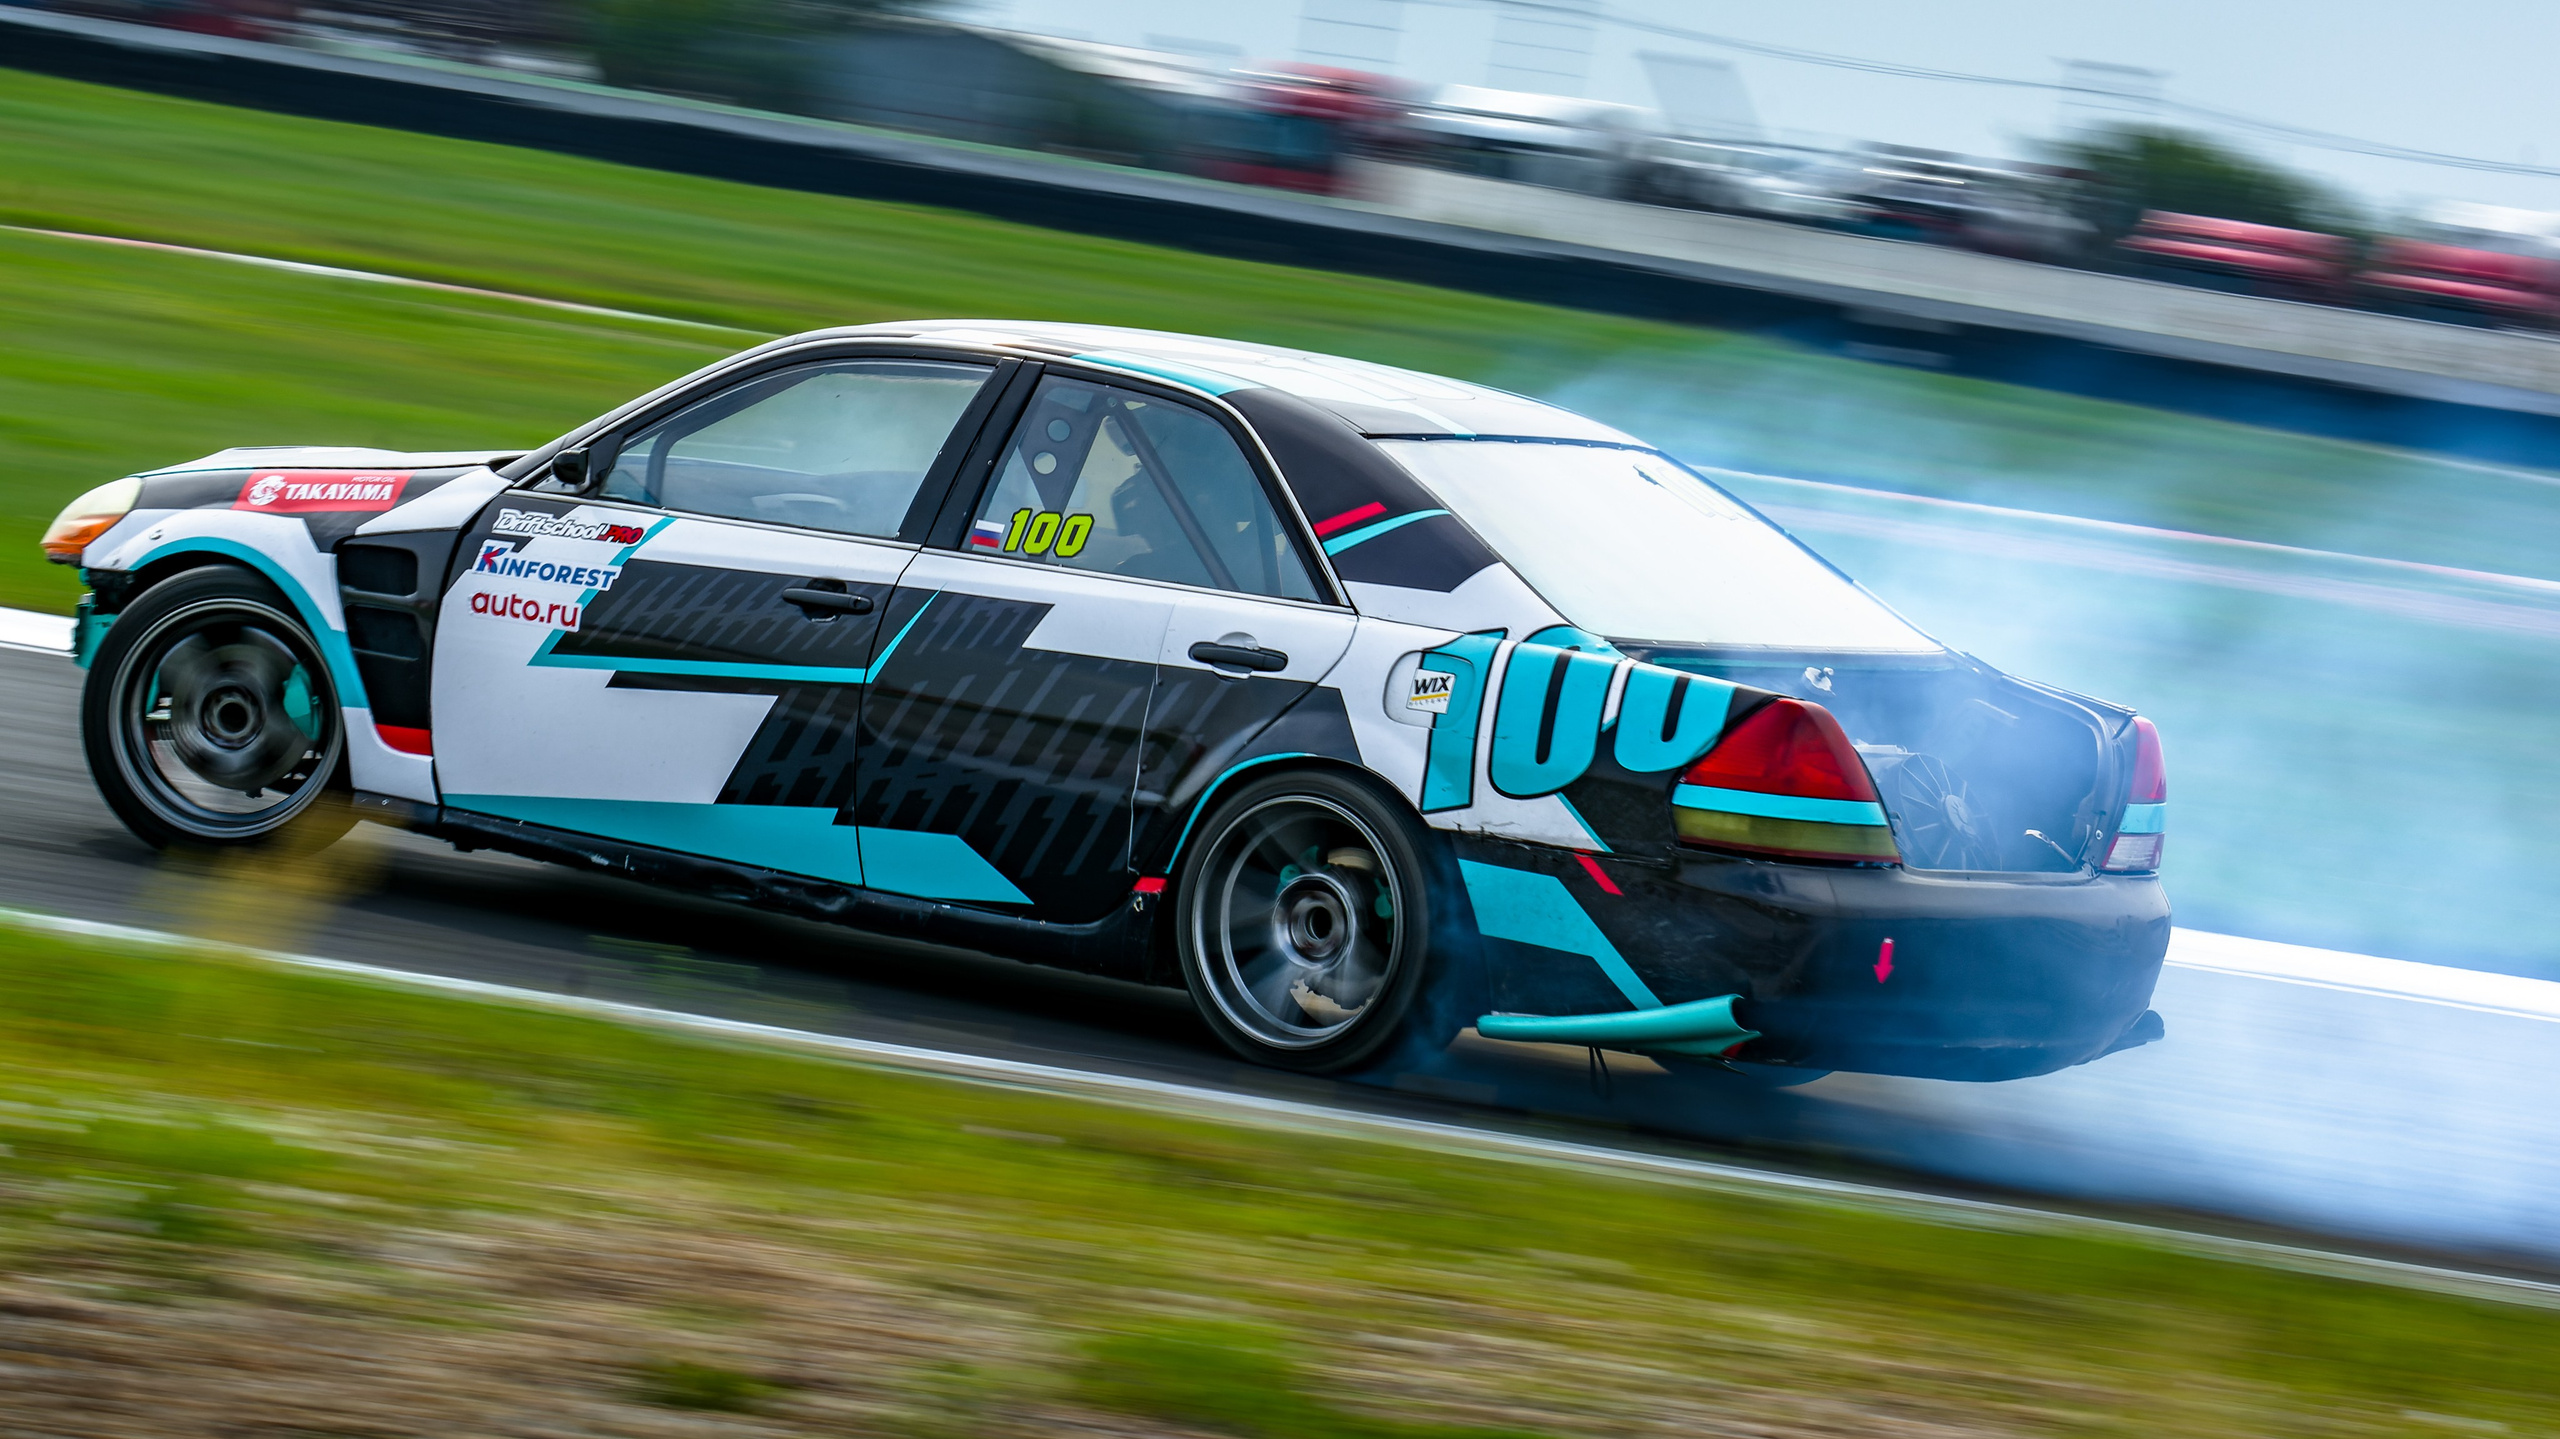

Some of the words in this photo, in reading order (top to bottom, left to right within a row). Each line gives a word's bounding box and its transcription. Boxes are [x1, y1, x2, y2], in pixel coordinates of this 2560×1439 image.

[284, 483, 395, 501] TAKAYAMA
[1003, 508, 1095, 558] 100
[475, 545, 617, 589] KINFOREST
[471, 592, 578, 627] auto.ru
[1414, 675, 1451, 695] WIX
